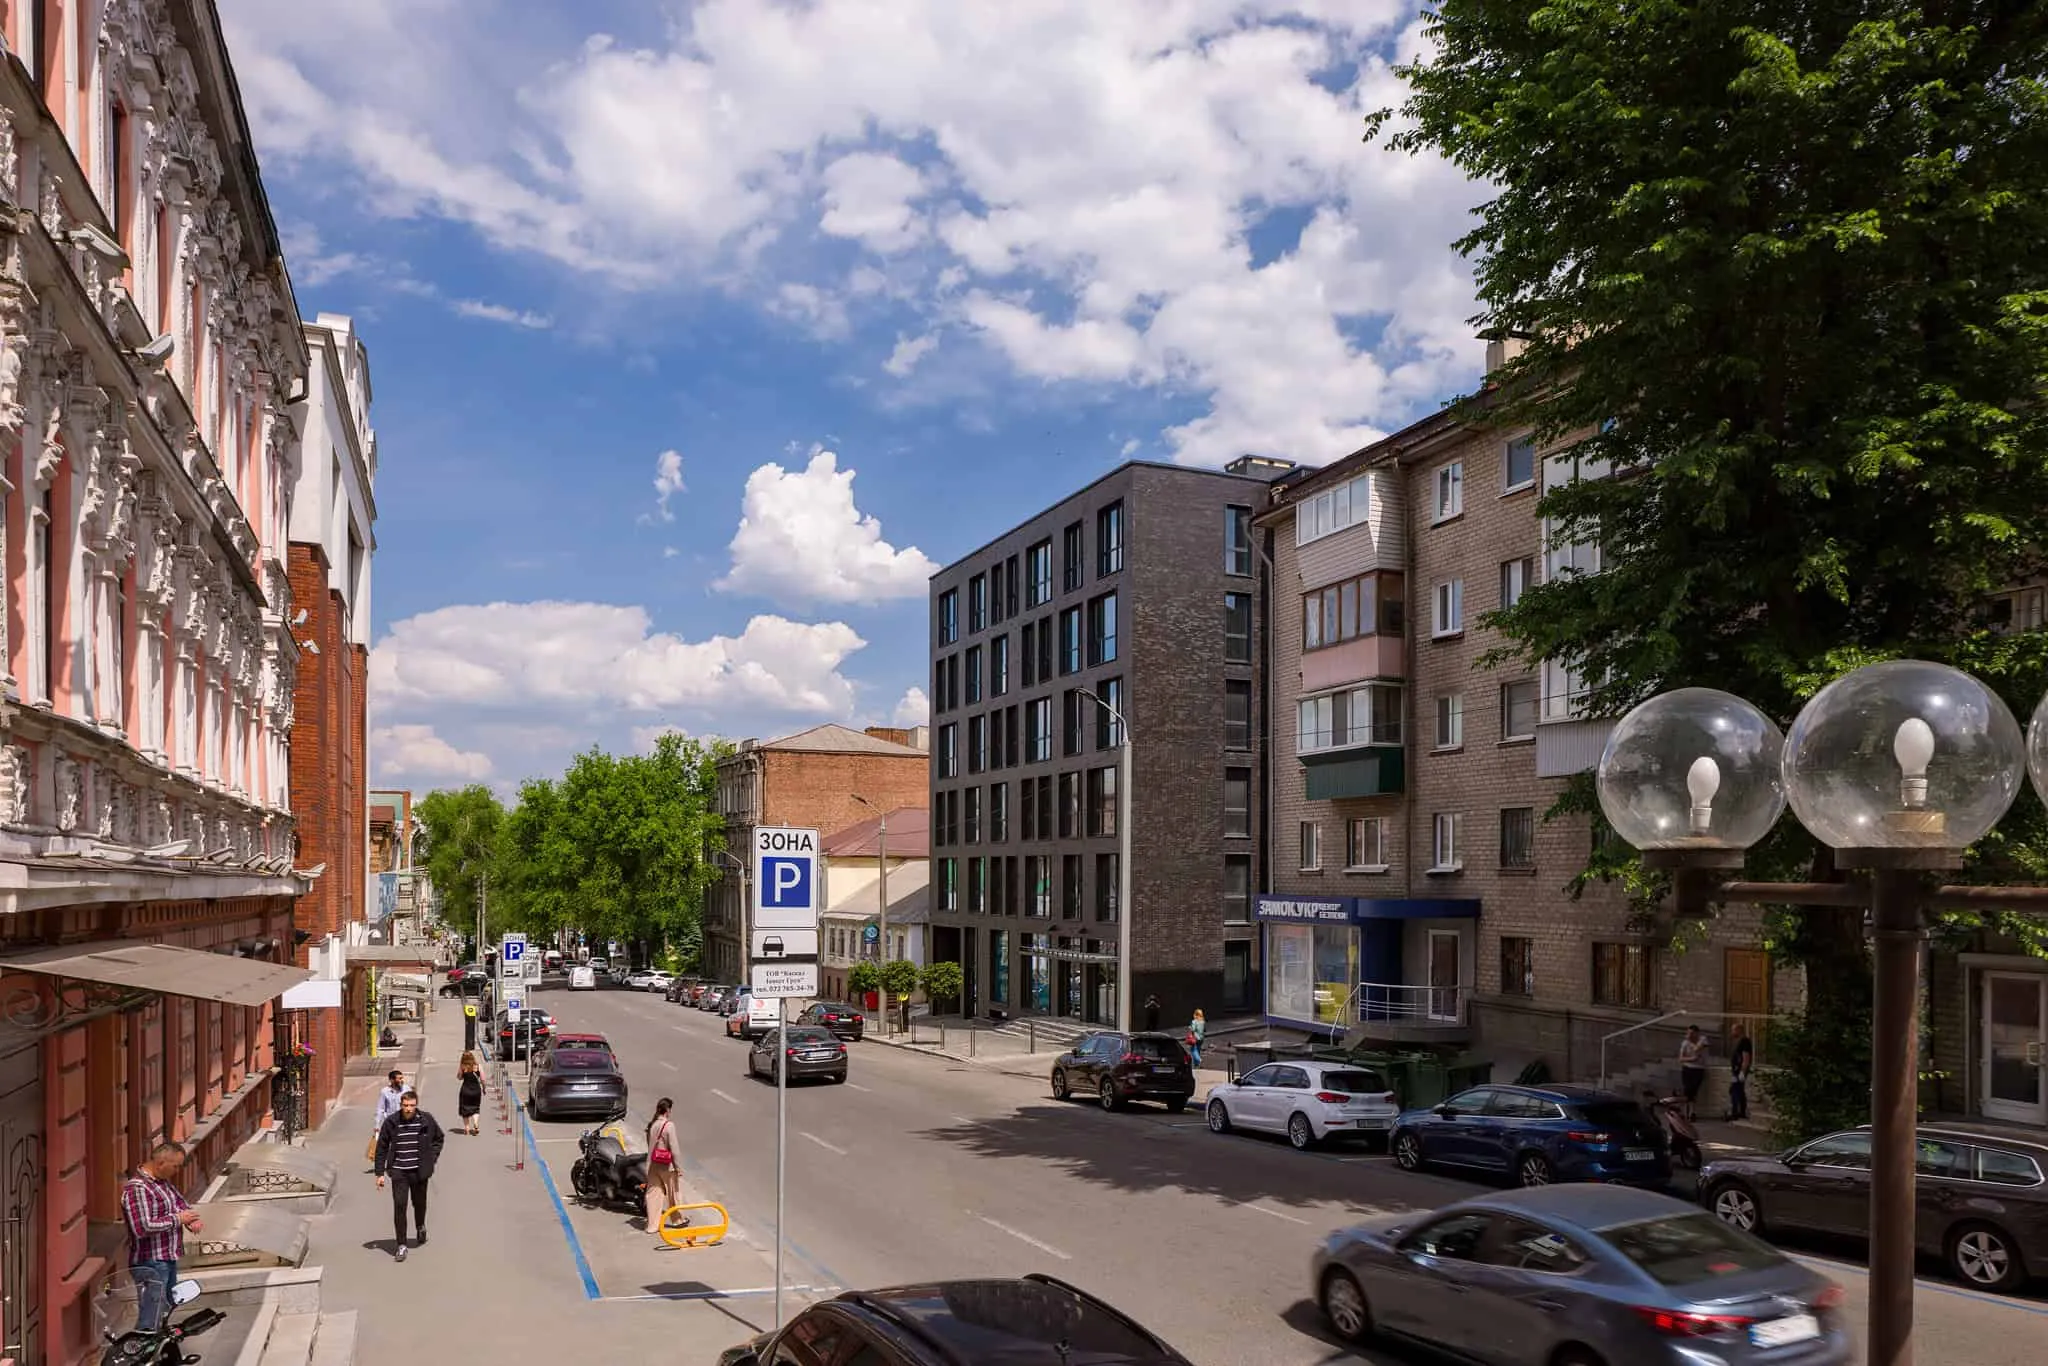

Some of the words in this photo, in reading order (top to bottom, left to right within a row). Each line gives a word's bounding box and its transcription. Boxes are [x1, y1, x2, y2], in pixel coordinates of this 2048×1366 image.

[759, 832, 813, 851] ЗОНА
[775, 862, 801, 902] P
[509, 944, 520, 959] P
[526, 963, 537, 977] P
